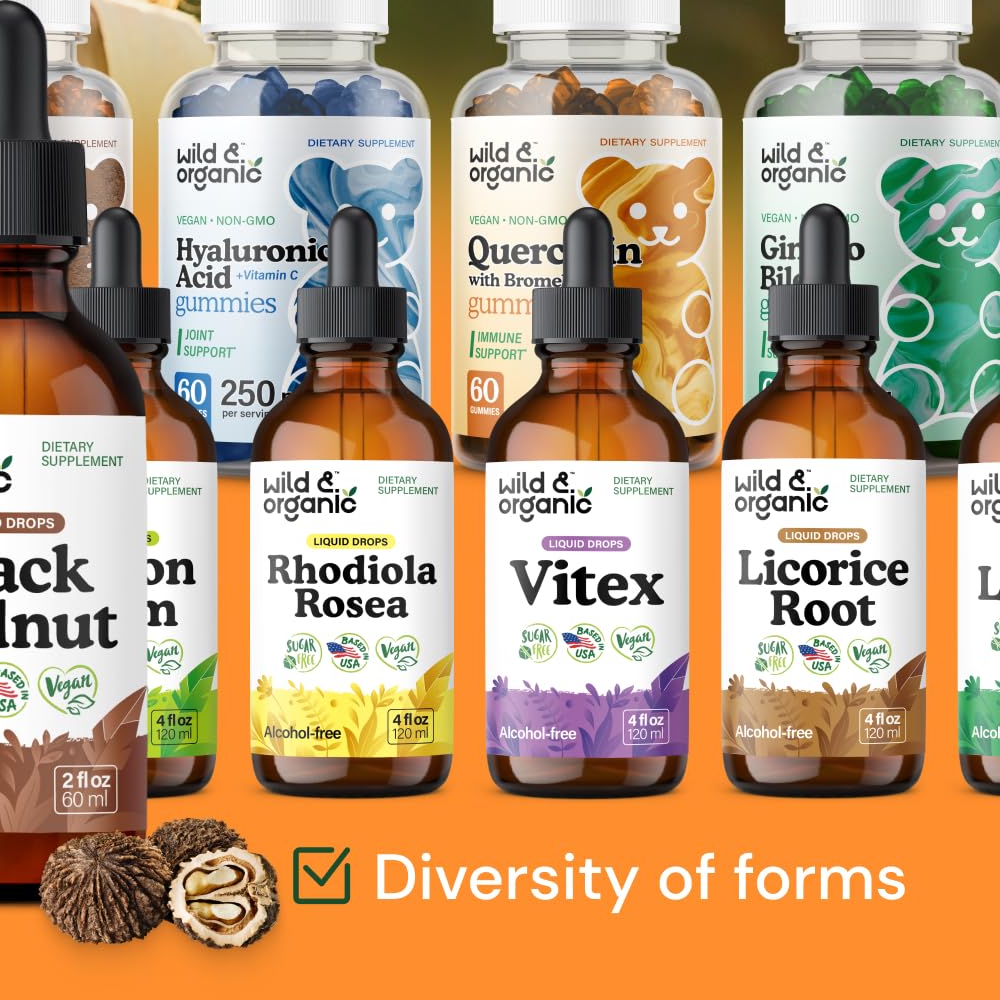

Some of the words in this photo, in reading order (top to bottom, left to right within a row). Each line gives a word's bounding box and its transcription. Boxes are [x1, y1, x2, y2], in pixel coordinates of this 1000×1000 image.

[308, 139, 354, 147] DIETARY
[358, 139, 415, 148] SUPPLEMENT
[600, 138, 645, 146] DIETARY
[650, 139, 706, 147] SUPPLEMENT
[900, 139, 945, 147] DIETARY
[177, 143, 217, 164] wild
[470, 142, 509, 162] wild
[762, 142, 800, 163] wild
[177, 160, 262, 191] organic
[470, 159, 554, 190] organic
[761, 159, 846, 191] organic
[177, 216, 207, 225] VEGAN
[216, 216, 275, 225] NON-GMO
[470, 216, 500, 225] VEGAN
[761, 213, 791, 223] VEGAN
[176, 237, 329, 265] Hyaluronic
[468, 234, 643, 271] Quercin
[760, 234, 865, 261] Gino
[176, 265, 232, 288] Acid
[290, 270, 298, 280] C
[468, 272, 500, 287] with
[175, 292, 277, 317] gummies
[185, 329, 214, 341] JOINT
[478, 332, 522, 344] IMMUNE
[183, 346, 232, 358] SUPPORT
[475, 347, 525, 360] SUPPORT
[177, 378, 207, 405] 60
[221, 379, 275, 407] 250
[470, 377, 499, 403] 60
[470, 406, 500, 416] GUMMIES
[41, 441, 94, 452] DIETARY
[41, 455, 123, 467] SUPPLEMENT
[264, 471, 309, 494] wild
[378, 476, 417, 484] DIETARY
[499, 472, 544, 494] wild
[613, 477, 653, 485] DIETARY
[735, 469, 781, 492] wild
[850, 475, 889, 483] DIETARY
[378, 486, 438, 495] SUPPLEMENT
[613, 487, 674, 495] SUPPLEMENT
[850, 484, 911, 493] SUPPLEMENT
[264, 489, 357, 522] organic
[499, 490, 592, 523] organic
[735, 488, 829, 521] organic
[6, 517, 55, 529] DROPS
[314, 537, 349, 547] LIQUID
[352, 538, 388, 546] DROPS
[785, 531, 821, 541] LIQUID
[824, 531, 860, 541] DROPS
[549, 540, 585, 549] LIQUID
[587, 540, 623, 548] DROPS
[268, 554, 437, 585] Rhodiola
[739, 550, 909, 586] Licorice
[510, 559, 664, 606] Vitex
[294, 588, 408, 618] Rosea
[770, 590, 876, 626] Root
[45, 674, 93, 700] Vegan
[264, 726, 341, 739] Alcohol-free
[500, 727, 577, 740] Alcohol-free
[735, 725, 813, 739] Alcohol-free
[62, 773, 74, 788] 2
[62, 792, 83, 807] 60
[88, 790, 108, 806] ml
